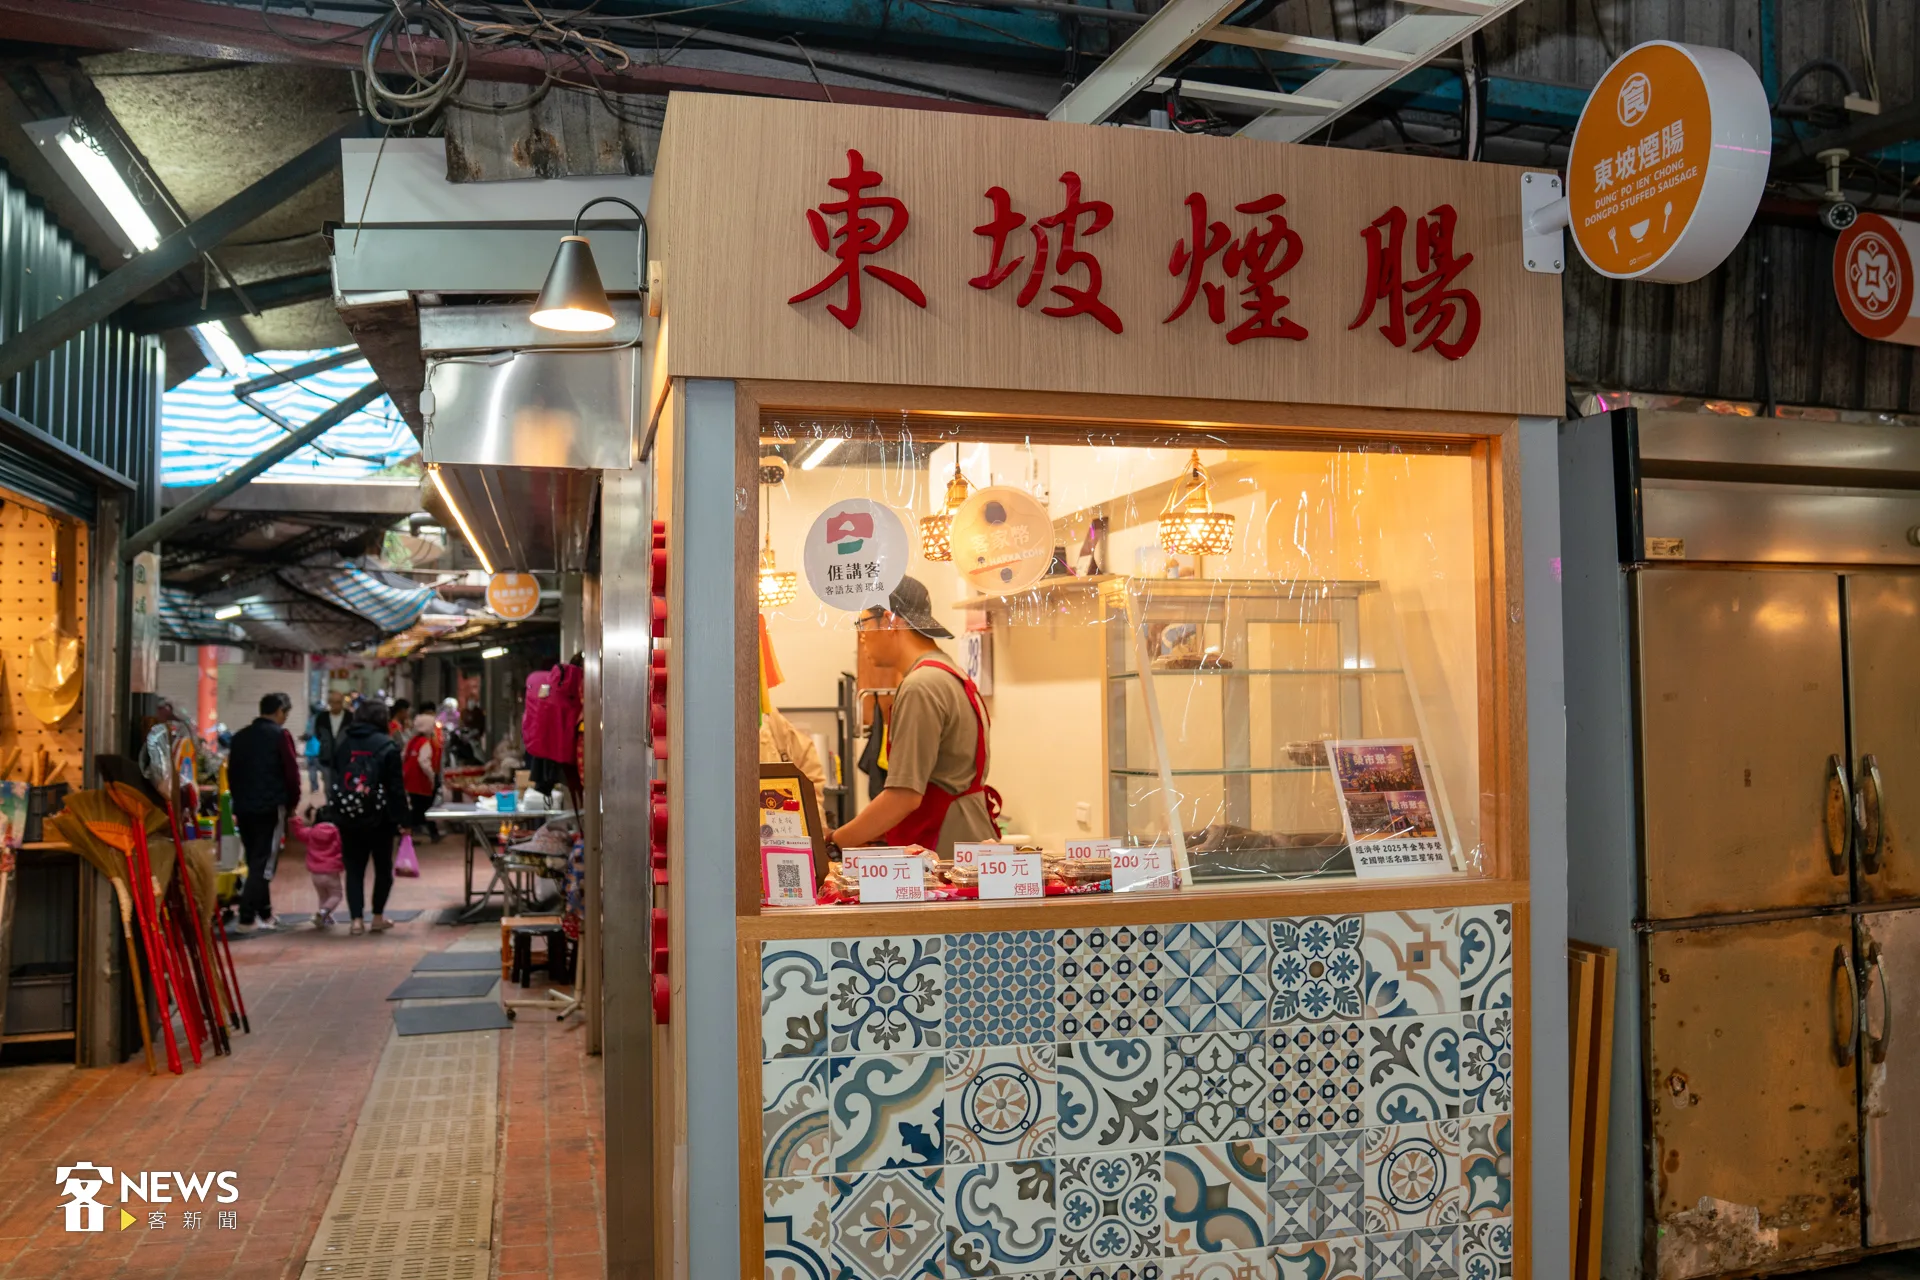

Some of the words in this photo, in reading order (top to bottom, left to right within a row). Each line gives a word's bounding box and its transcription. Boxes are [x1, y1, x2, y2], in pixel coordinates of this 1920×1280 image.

[1622, 78, 1647, 122] 食
[1593, 119, 1685, 193] 東坡煙腸
[1653, 158, 1685, 182] CHONG
[1584, 204, 1619, 228] DONGPO
[1620, 187, 1656, 212] STUFFED
[1657, 166, 1698, 194] SAUSAGE
[787, 148, 1482, 361] 東坡煙腸
[956, 851, 973, 863] 50
[1068, 846, 1091, 859] 100
[1113, 855, 1139, 869] 200
[1143, 852, 1160, 871] 元
[861, 864, 888, 878] 100
[892, 862, 911, 880] 元
[980, 861, 1007, 875] 150
[1011, 858, 1029, 877] 元
[895, 886, 923, 900] 煙腸
[1013, 882, 1040, 896] 煙腸
